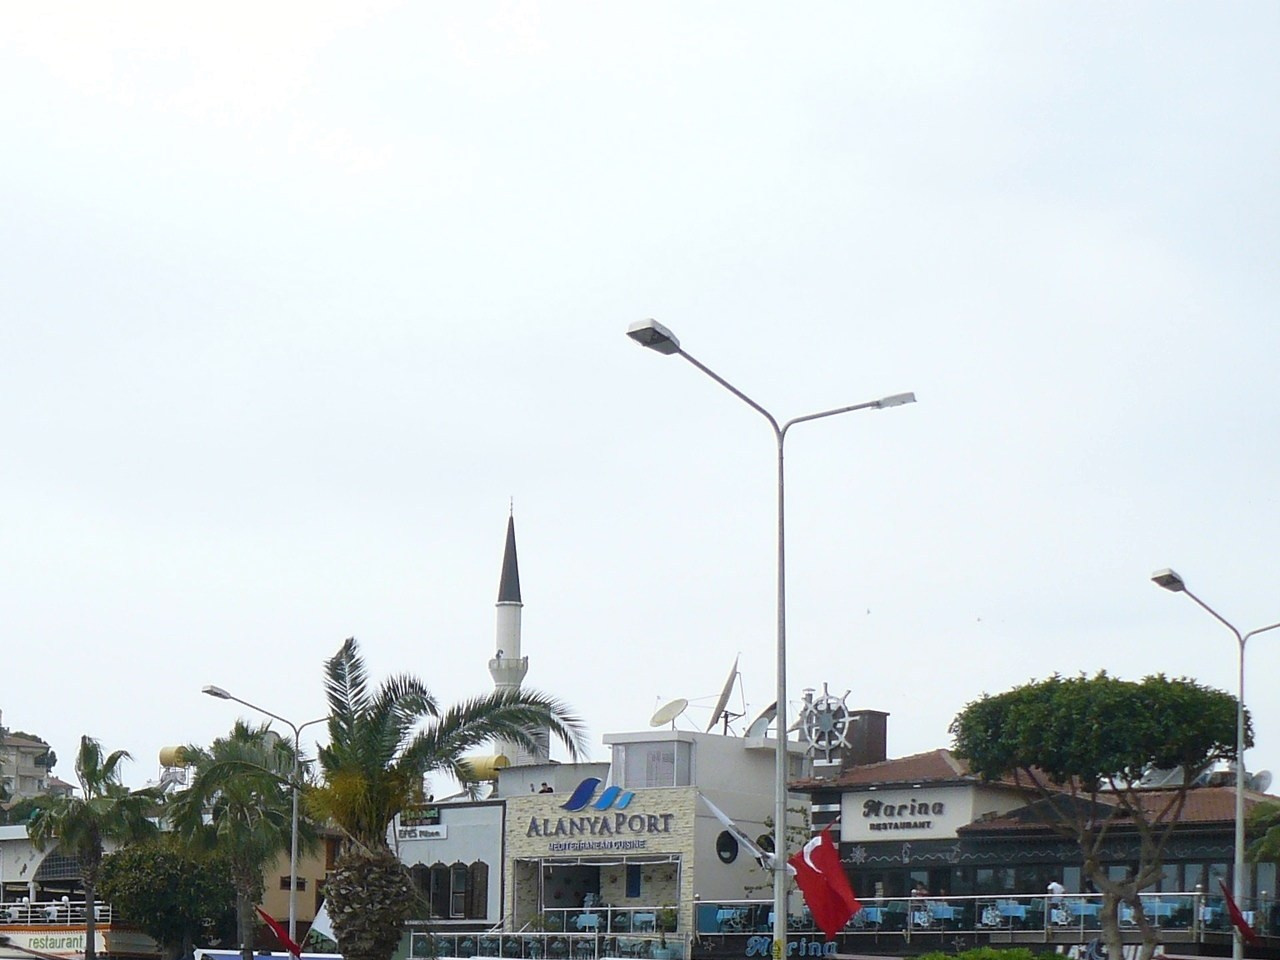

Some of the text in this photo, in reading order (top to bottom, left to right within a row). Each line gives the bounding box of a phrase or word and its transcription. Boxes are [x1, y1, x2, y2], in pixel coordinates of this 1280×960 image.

[862, 799, 944, 818] Marina
[869, 821, 932, 831] RESTAURANT
[549, 840, 646, 851] MEDITERRANEAN CUISINE
[29, 936, 84, 949] restaurant
